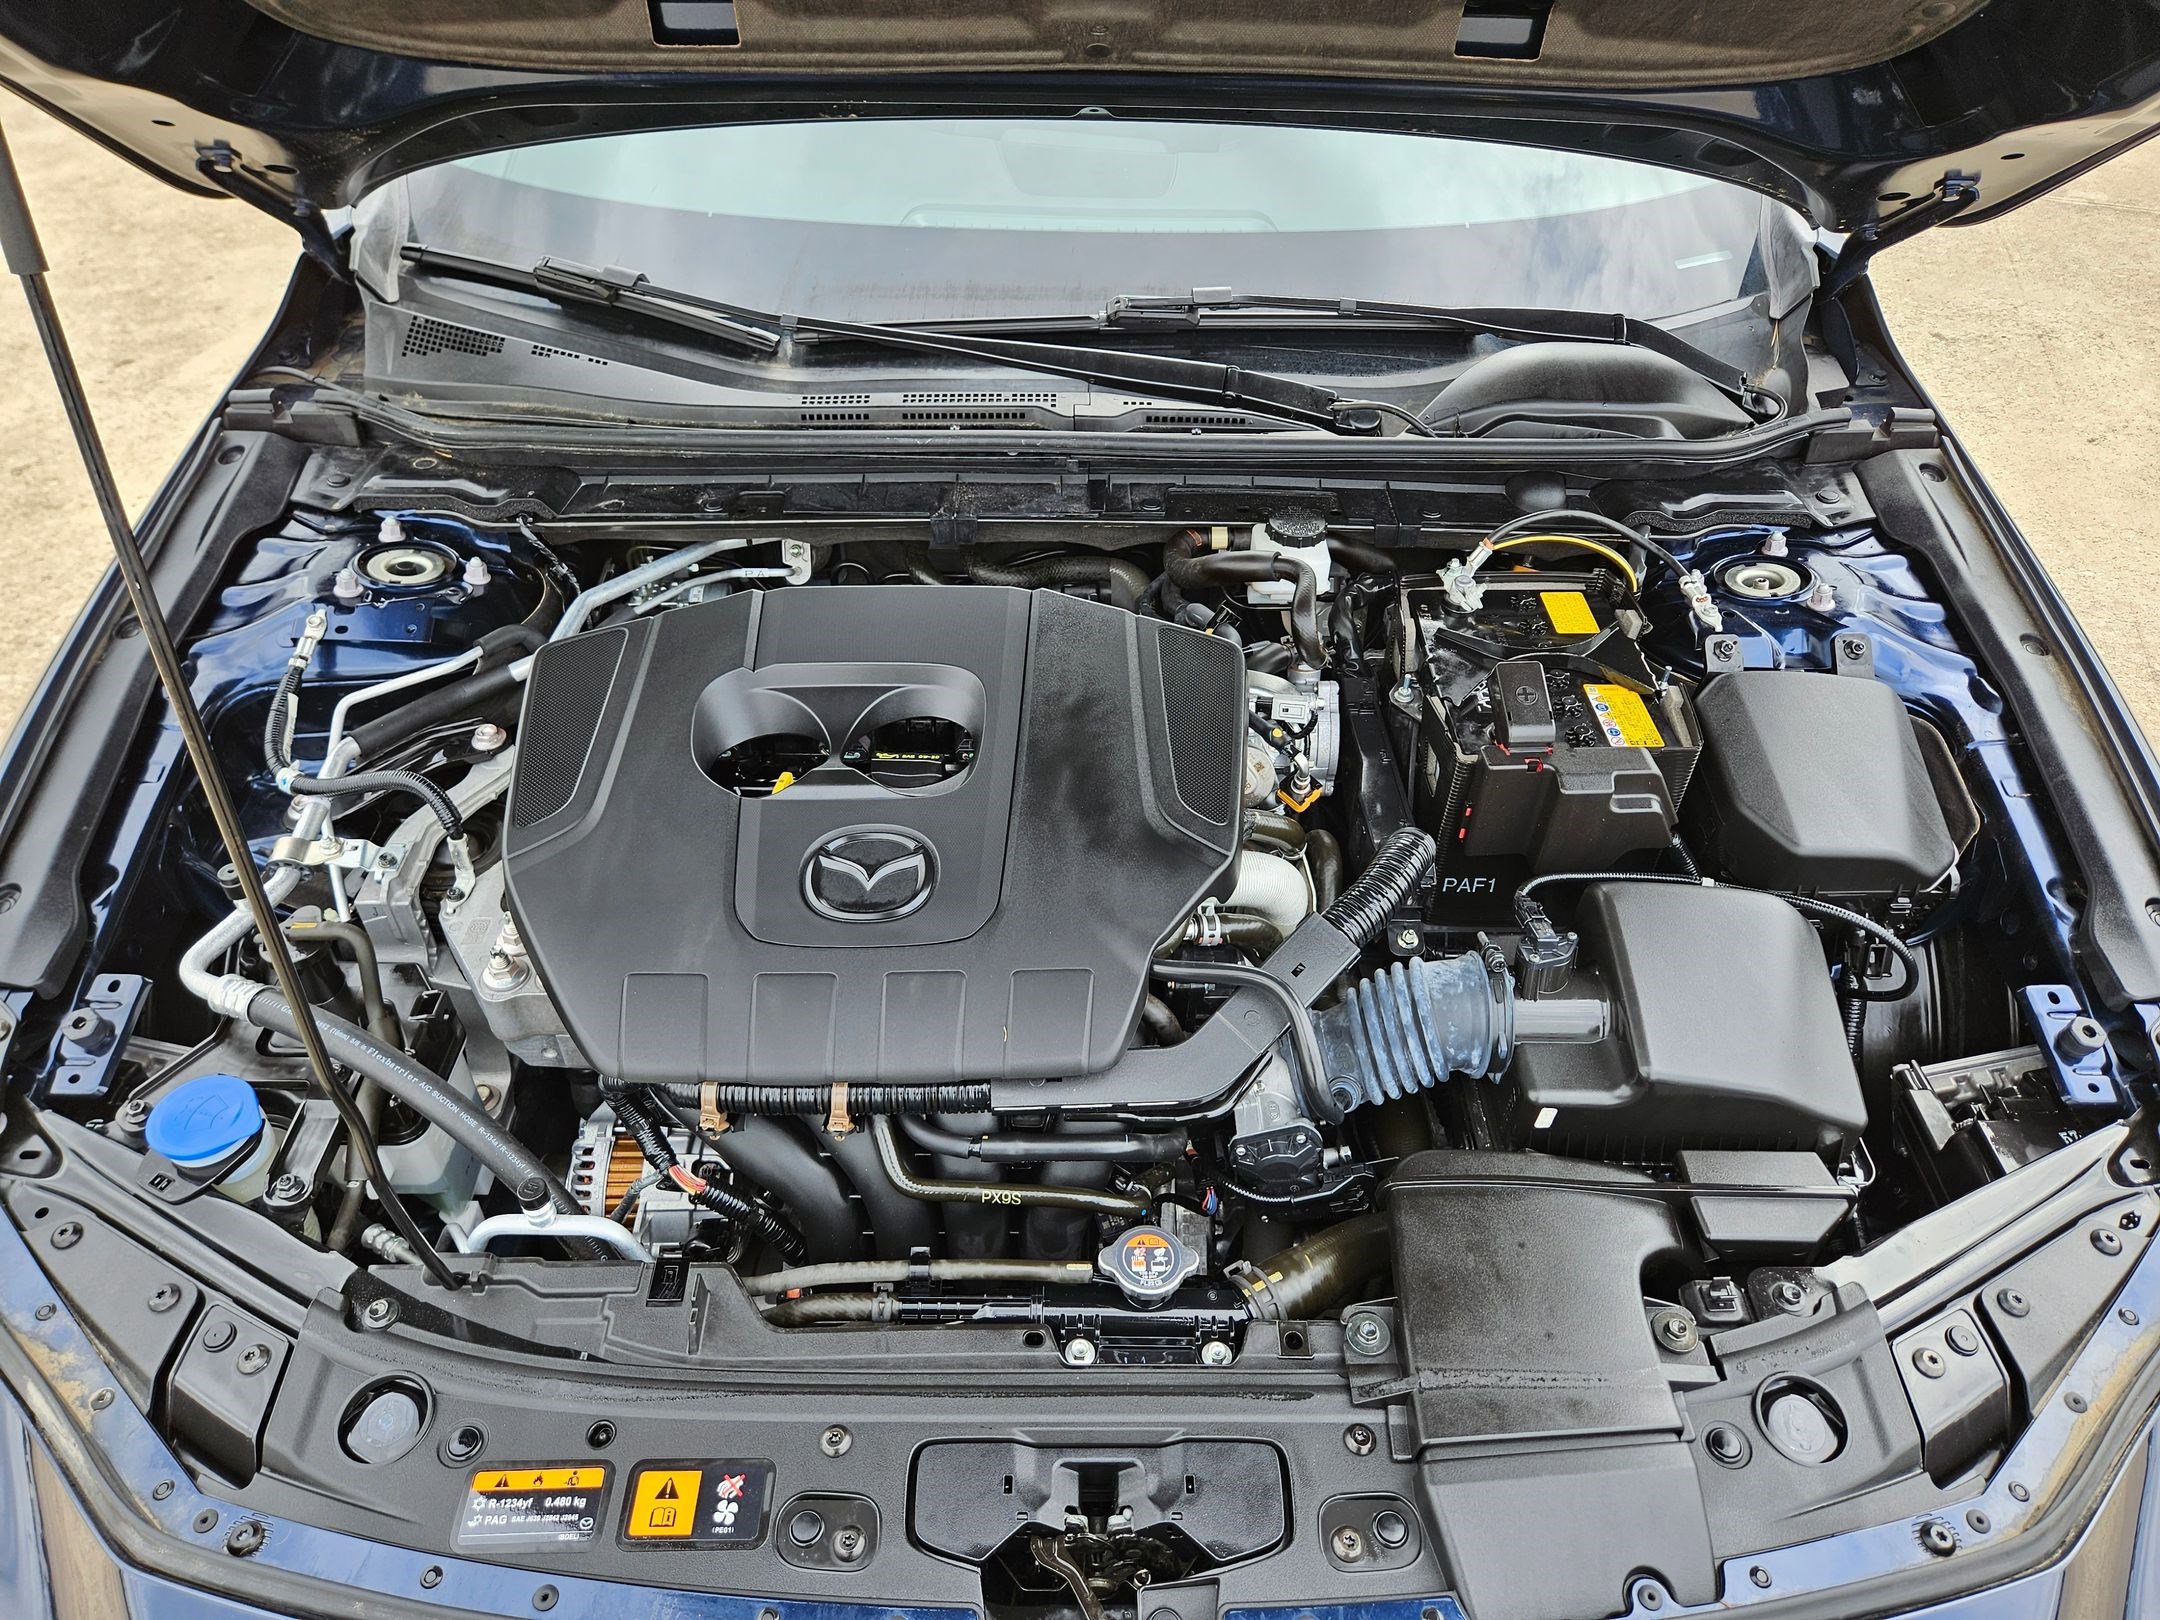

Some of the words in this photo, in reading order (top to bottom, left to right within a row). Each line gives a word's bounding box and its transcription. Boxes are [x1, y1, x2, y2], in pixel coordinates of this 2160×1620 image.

[1442, 877, 1496, 893] PAF1
[366, 1047, 419, 1083] Flexbarrier
[419, 1081, 433, 1093] A/C
[431, 1090, 460, 1114] SUCTION
[459, 1110, 479, 1128] HOSE
[981, 1190, 1022, 1205] PX9S
[488, 1497, 534, 1510] R-1234yf
[545, 1496, 572, 1508] 0.480
[573, 1496, 587, 1509] kg
[484, 1514, 508, 1526] PAG
[711, 1526, 735, 1534] (PE01)
